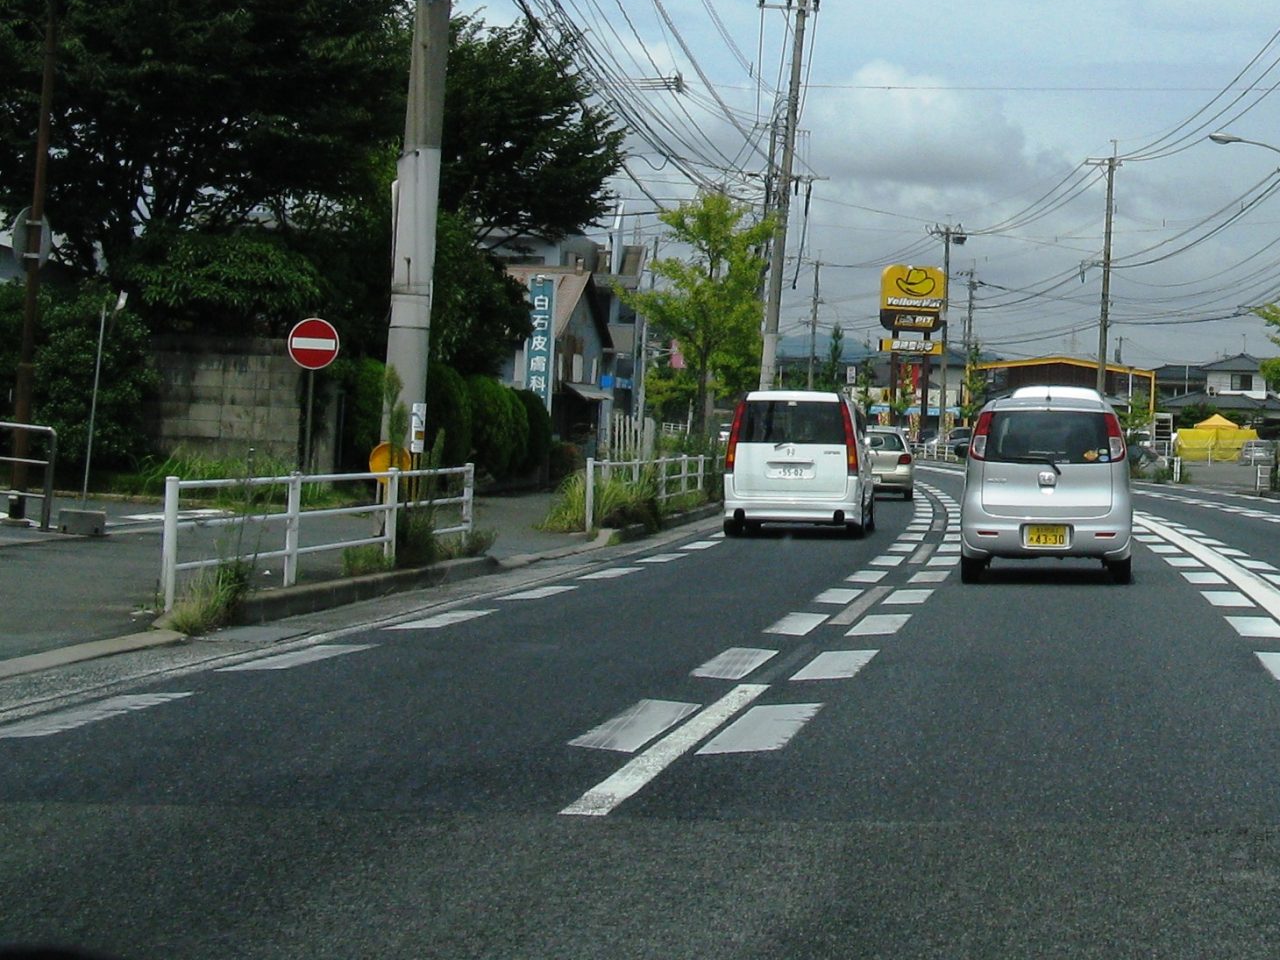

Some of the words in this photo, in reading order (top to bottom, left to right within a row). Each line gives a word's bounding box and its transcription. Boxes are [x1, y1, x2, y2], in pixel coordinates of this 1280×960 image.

[529, 295, 549, 398] 白石皮膚科
[914, 315, 935, 324] PIT
